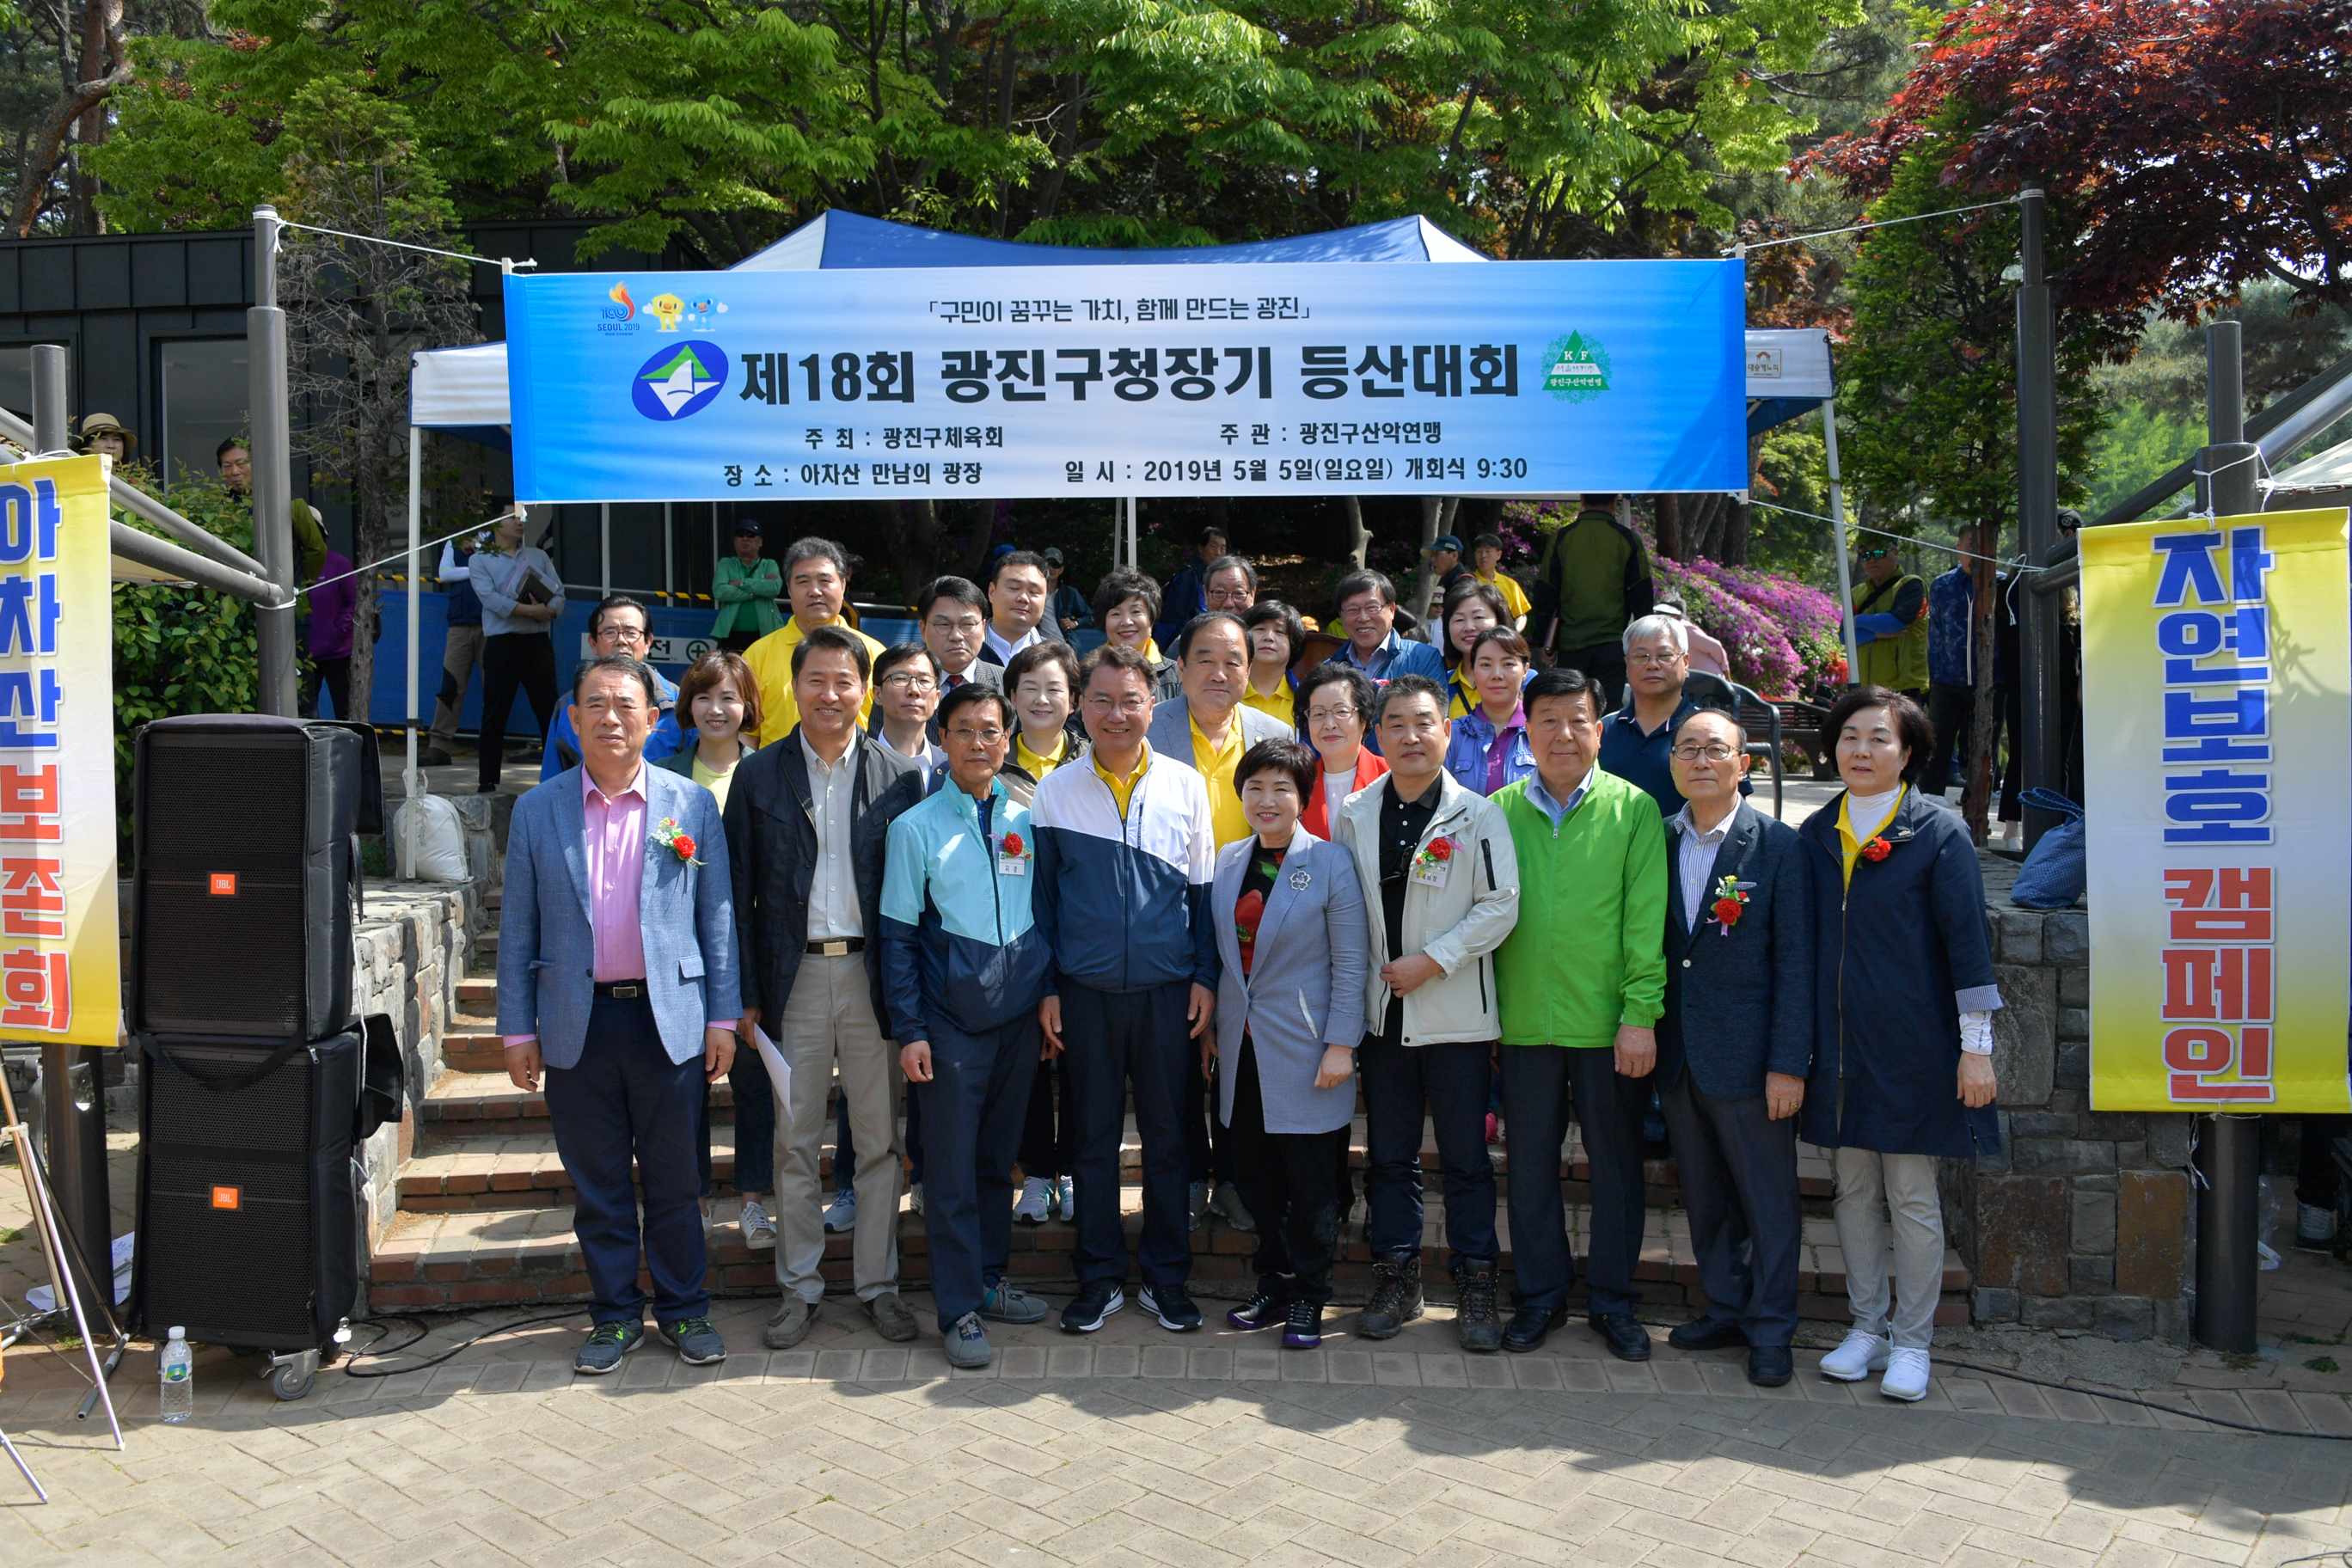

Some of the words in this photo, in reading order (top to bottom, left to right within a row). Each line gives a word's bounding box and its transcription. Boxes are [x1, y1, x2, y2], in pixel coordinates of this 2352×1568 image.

[1010, 299, 1074, 322] 꿈꾸는
[1080, 298, 1130, 324] 가치,
[1136, 297, 1179, 321] 함께
[1186, 297, 1250, 321] 만드는
[739, 351, 916, 405] 제18회
[940, 346, 1273, 403] 광진구청장기
[1301, 344, 1519, 401] 등산대회
[883, 426, 1004, 450] 광진구체육회
[1300, 421, 1442, 445] 광진구산악연맹
[800, 463, 861, 486] 아차산
[872, 462, 931, 485] 만남의
[942, 462, 983, 485] 광장
[1143, 459, 1222, 481] 2019년
[1234, 459, 1267, 481] 5월
[1279, 458, 1393, 481] 5일(일요일)
[1406, 457, 1465, 480] 개회식
[1477, 457, 1528, 479] 9:30
[2153, 526, 2275, 844] 자연보호
[216, 879, 231, 890] JBL
[2161, 867, 2275, 1102] 캠페인
[217, 1192, 232, 1203] JBL
